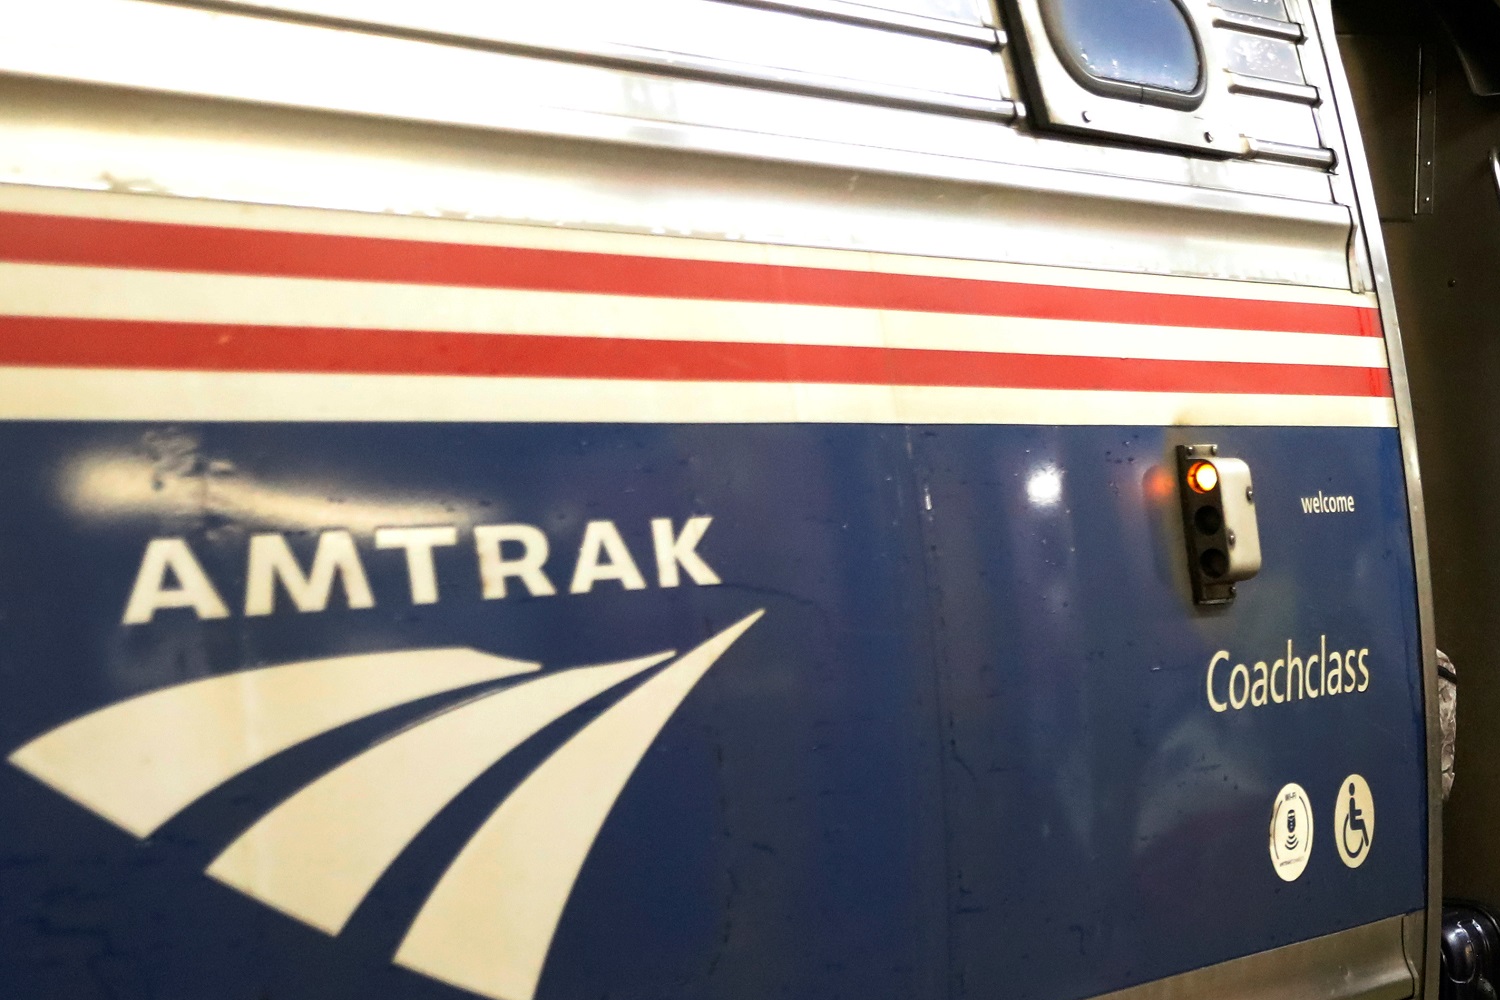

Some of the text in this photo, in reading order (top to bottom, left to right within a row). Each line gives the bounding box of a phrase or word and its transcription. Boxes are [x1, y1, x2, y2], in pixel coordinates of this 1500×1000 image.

[1301, 490, 1355, 514] welcome
[122, 515, 722, 626] AMTRAK
[1206, 634, 1370, 713] Coachclass
